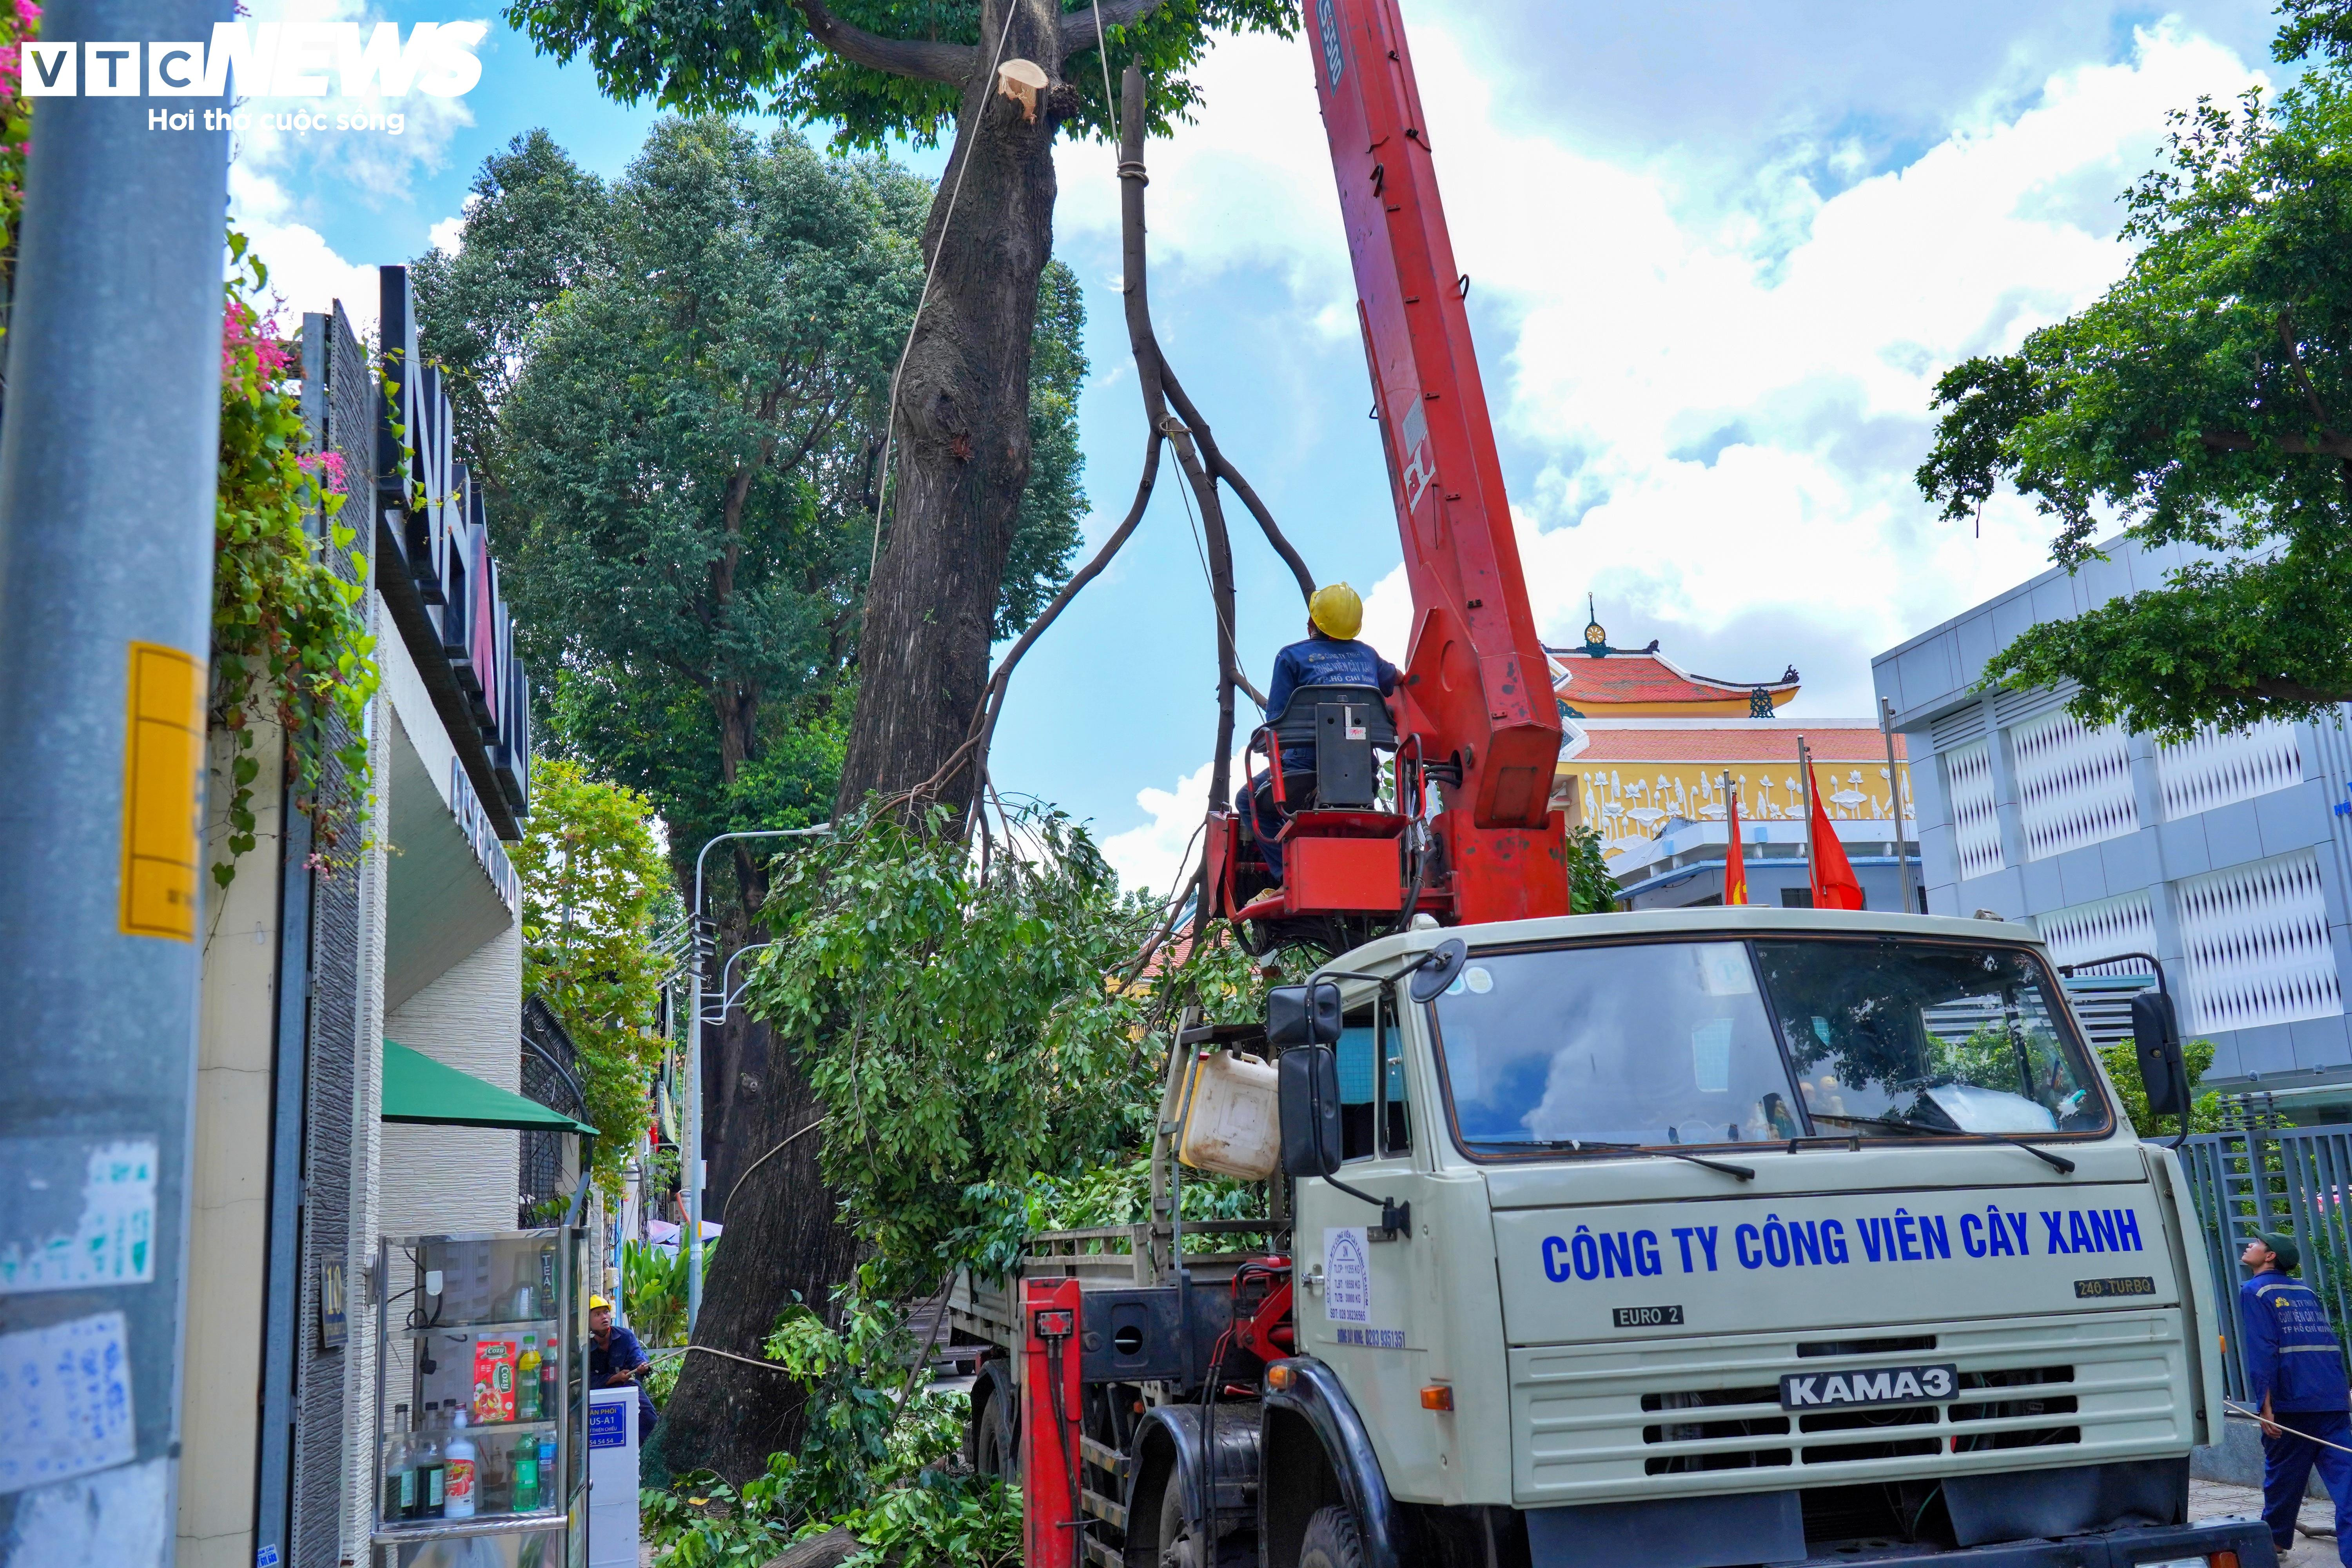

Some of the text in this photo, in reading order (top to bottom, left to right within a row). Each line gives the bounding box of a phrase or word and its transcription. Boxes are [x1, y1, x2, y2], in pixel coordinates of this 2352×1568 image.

[1345, 673, 1360, 682] CHÍ
[1541, 1204, 2143, 1283] CÔNG TY CÔNG VIÊN CÂY XANH
[1354, 1265, 1360, 1274] KG
[1355, 1279, 1361, 1289] KG
[2079, 1279, 2151, 1295] 240 TURBO
[1355, 1294, 1361, 1303] KG
[1619, 1307, 1679, 1325] EURO 2
[1365, 1328, 1379, 1346] 0283
[1380, 1329, 1406, 1348] 9351351
